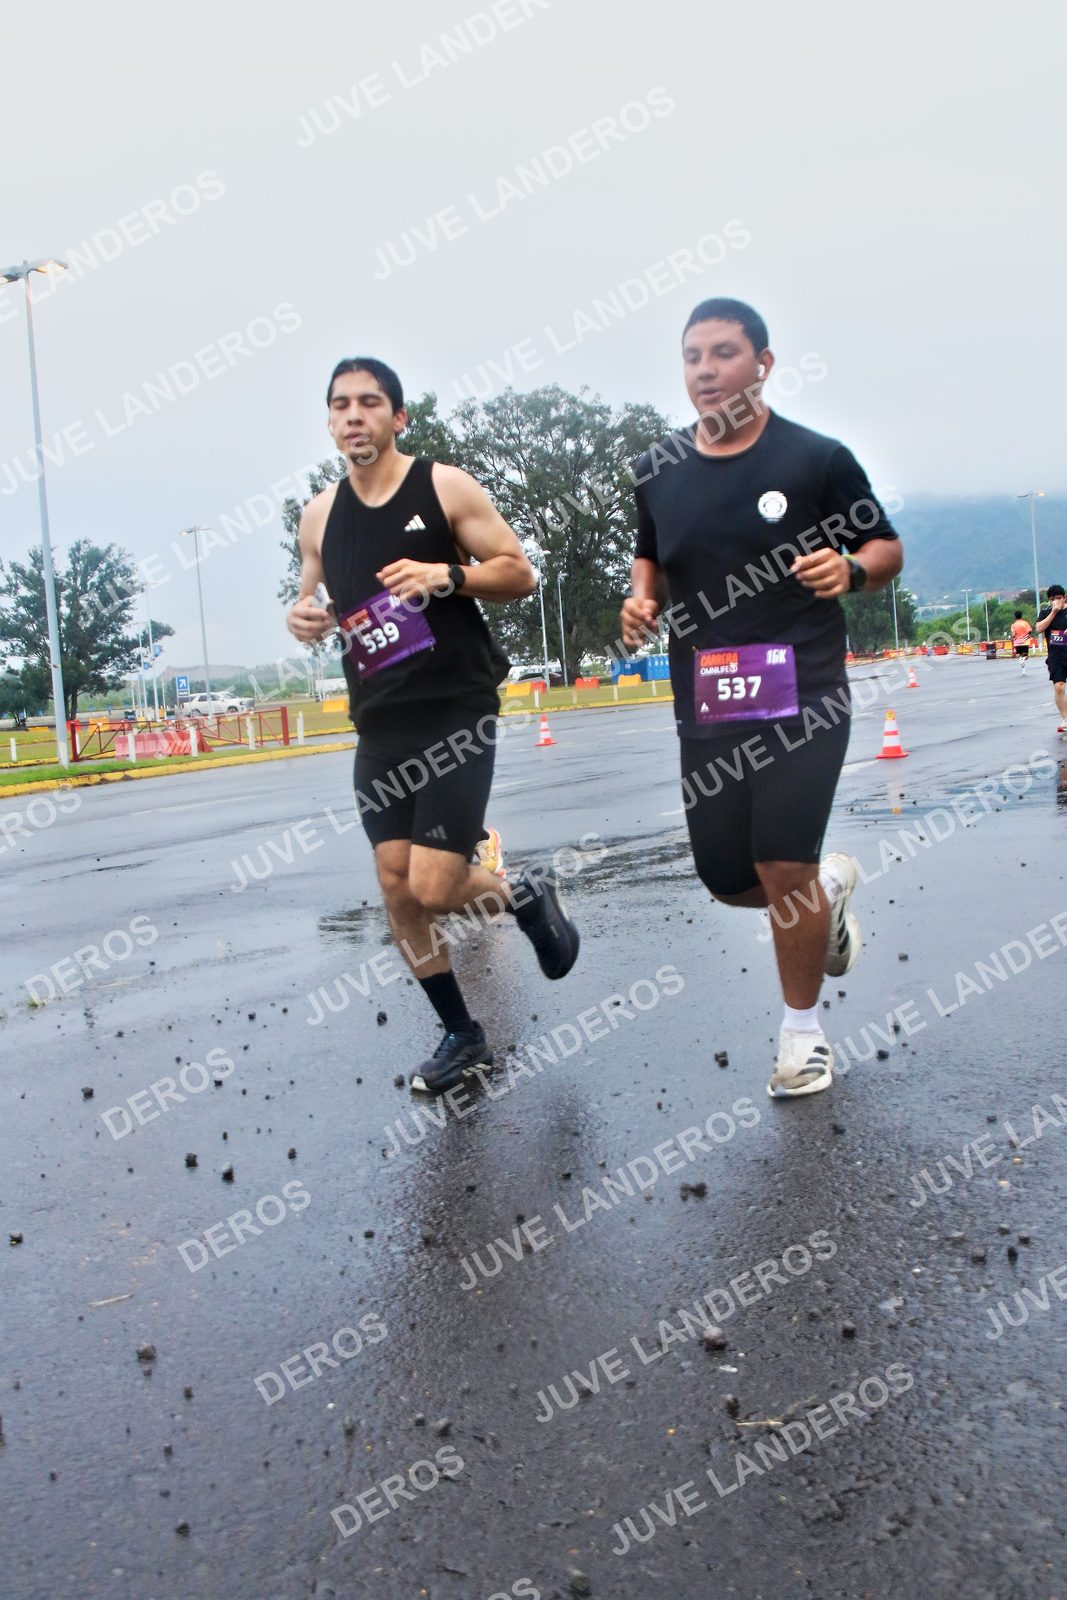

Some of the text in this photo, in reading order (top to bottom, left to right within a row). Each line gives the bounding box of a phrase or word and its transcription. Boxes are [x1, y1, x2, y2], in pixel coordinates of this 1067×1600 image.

[363, 621, 400, 654] 539
[700, 651, 739, 667] CARRERA
[700, 664, 730, 675] OMNILIFE
[717, 676, 762, 700] 537
